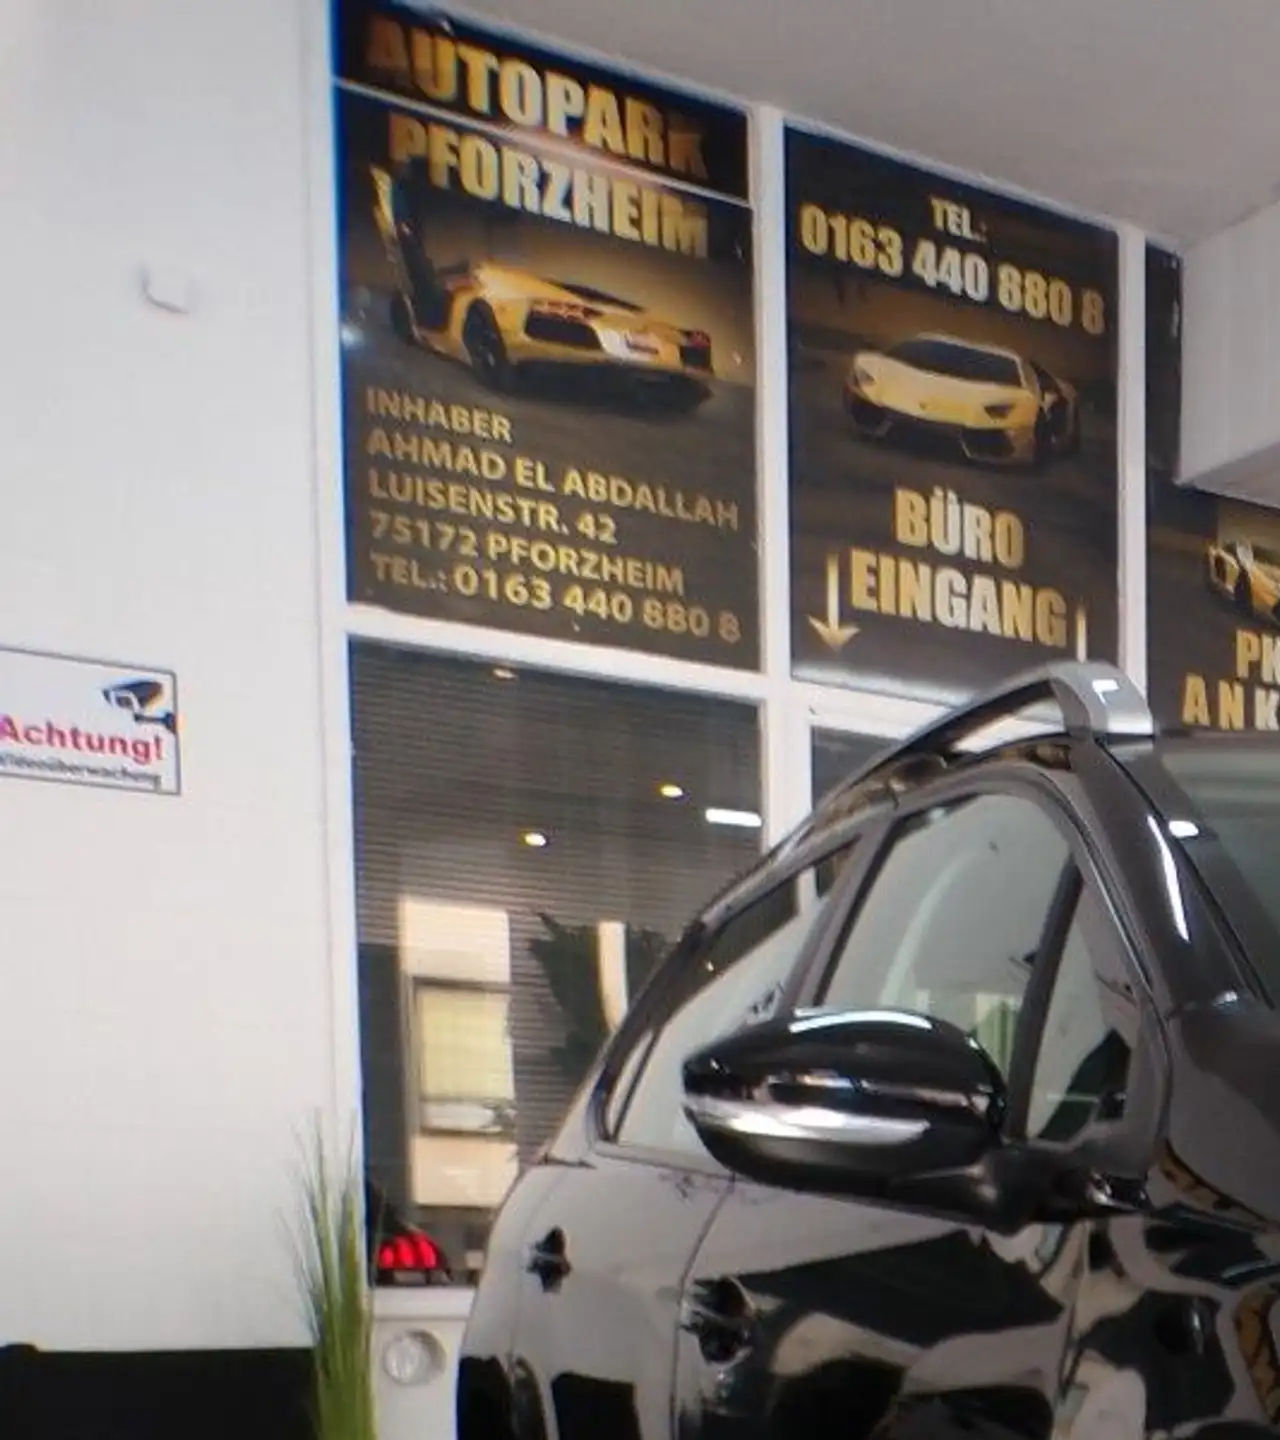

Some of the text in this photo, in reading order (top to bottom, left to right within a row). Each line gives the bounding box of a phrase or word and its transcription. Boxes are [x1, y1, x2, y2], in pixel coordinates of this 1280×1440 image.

[366, 14, 708, 180] AUTOPARK
[388, 111, 708, 258] PFORZHEIM
[800, 204, 1105, 335] 0163 440 880 8
[366, 386, 514, 443] INHABER
[366, 428, 740, 531] AHMAD EL ABDALLAH
[366, 469, 619, 545] LUISENSTR. 42
[369, 510, 685, 596] 75172 PFORZHEIM
[895, 485, 1025, 571] BÜRO
[453, 564, 552, 611] 0163
[563, 586, 633, 624] 440
[642, 601, 710, 639] 880
[718, 611, 742, 644] 8
[850, 546, 1068, 649] EINGANG
[0, 714, 164, 766] Achtung!
